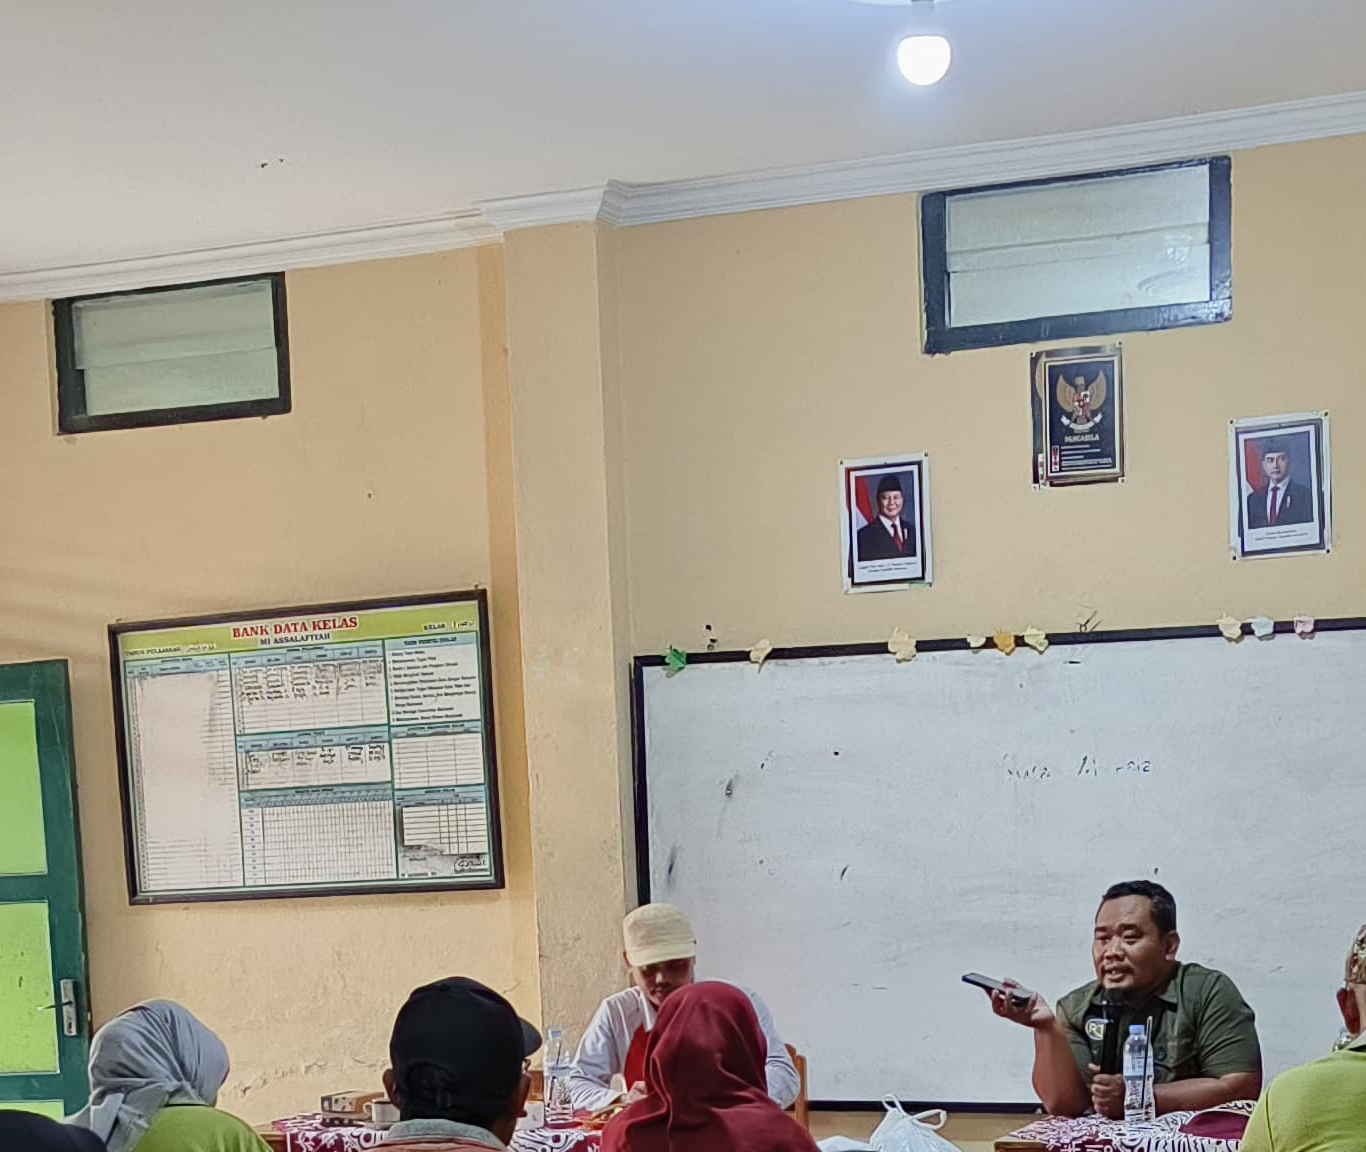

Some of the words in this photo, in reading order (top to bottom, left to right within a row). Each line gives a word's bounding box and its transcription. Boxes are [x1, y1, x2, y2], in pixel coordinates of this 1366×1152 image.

[232, 624, 270, 638] BANK
[273, 621, 309, 635] DATA
[312, 616, 358, 631] KELAS
